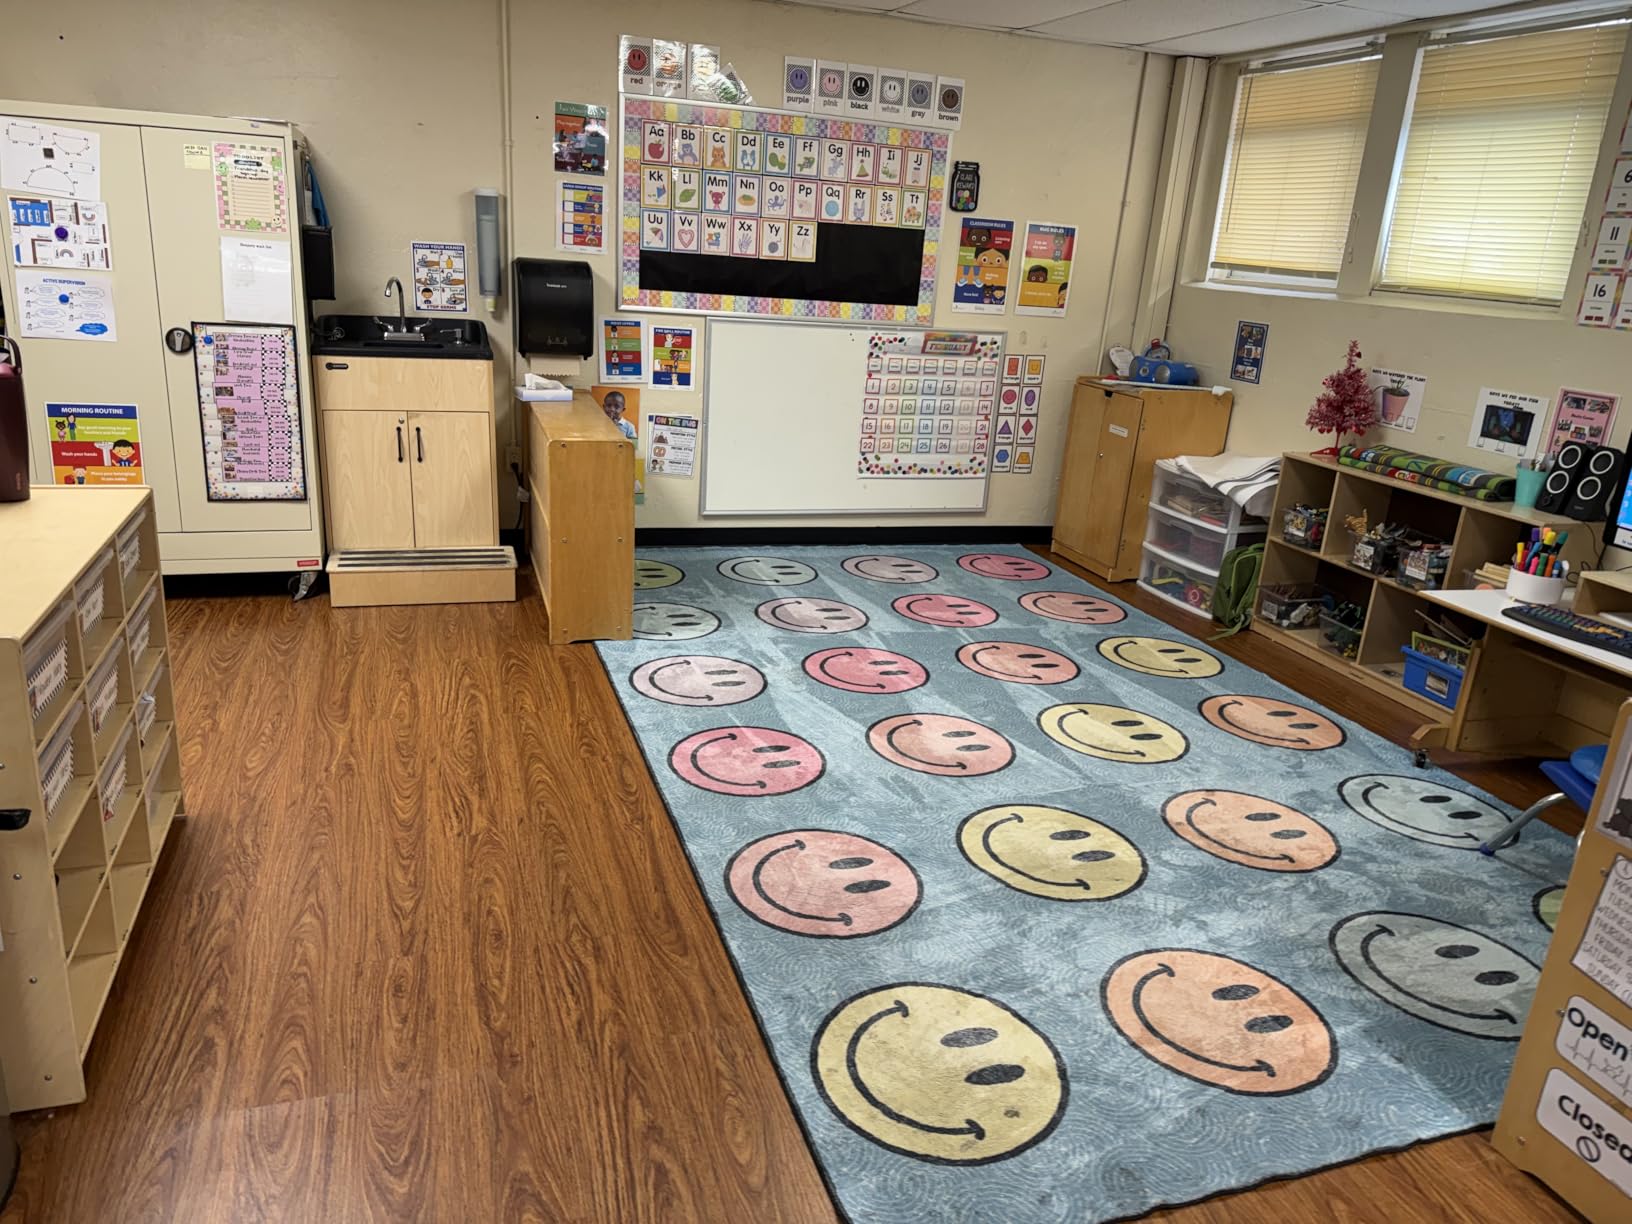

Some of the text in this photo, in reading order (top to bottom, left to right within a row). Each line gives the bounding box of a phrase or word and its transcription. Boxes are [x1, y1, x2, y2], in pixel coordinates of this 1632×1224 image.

[630, 76, 644, 85] red
[786, 95, 810, 104] purple
[822, 98, 838, 107] pink
[850, 102, 869, 111] black
[881, 106, 900, 114] white
[911, 110, 926, 119] gray
[938, 112, 959, 122] brown
[649, 126, 923, 166] Aa Bb Cc Dd Ee Ff Gg Hh Ii Jj
[1624, 169, 1632, 183] 6
[649, 171, 920, 204] Kk Ll Mm Nn Oo Pp Qq Rr Ss Tt
[648, 213, 810, 237] Uu Vv Ww Xx Yy Zz
[1609, 226, 1620, 241] 11
[1592, 283, 1607, 298] 16
[891, 383, 897, 391] 2
[908, 383, 913, 391] 3
[945, 384, 951, 392] 5
[868, 402, 874, 410] 8
[888, 402, 894, 410] 9
[904, 403, 913, 411] 10
[926, 403, 931, 411] 11
[656, 416, 666, 425] ON
[668, 418, 681, 426] THE
[865, 422, 873, 430] 15
[884, 422, 891, 430] 16
[903, 422, 909, 430] 17
[942, 423, 949, 431] 19
[863, 441, 872, 449] 22
[881, 441, 891, 449] 23
[938, 442, 948, 450] 26
[976, 442, 985, 450] 28
[1613, 878, 1632, 898] MON
[1608, 892, 1632, 914] TUES
[1598, 906, 1632, 933] WEDNES
[1595, 917, 1632, 949] THURSDA
[1594, 932, 1625, 959] FRIDAY
[1583, 940, 1622, 976] SATURDAY
[1586, 962, 1620, 990] SUNDAY
[1567, 1006, 1629, 1062] Open
